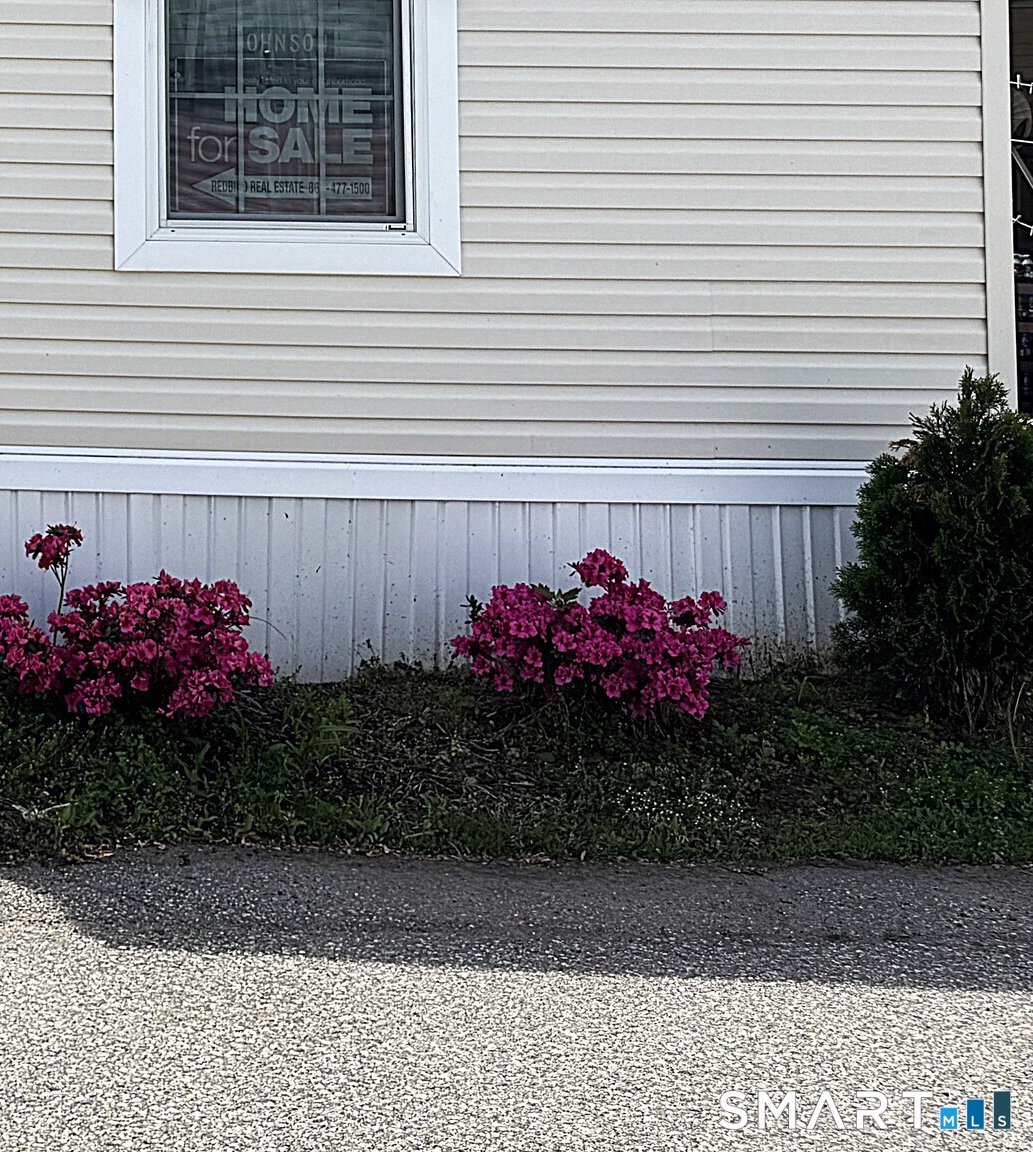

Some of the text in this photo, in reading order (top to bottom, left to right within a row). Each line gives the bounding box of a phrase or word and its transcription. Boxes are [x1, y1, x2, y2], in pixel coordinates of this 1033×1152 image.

[246, 33, 328, 52] OHNSO
[224, 86, 373, 123] HOME
[187, 126, 373, 164] for SALE
[211, 180, 370, 195] REDBID REAL ESTATE 86-477-1500
